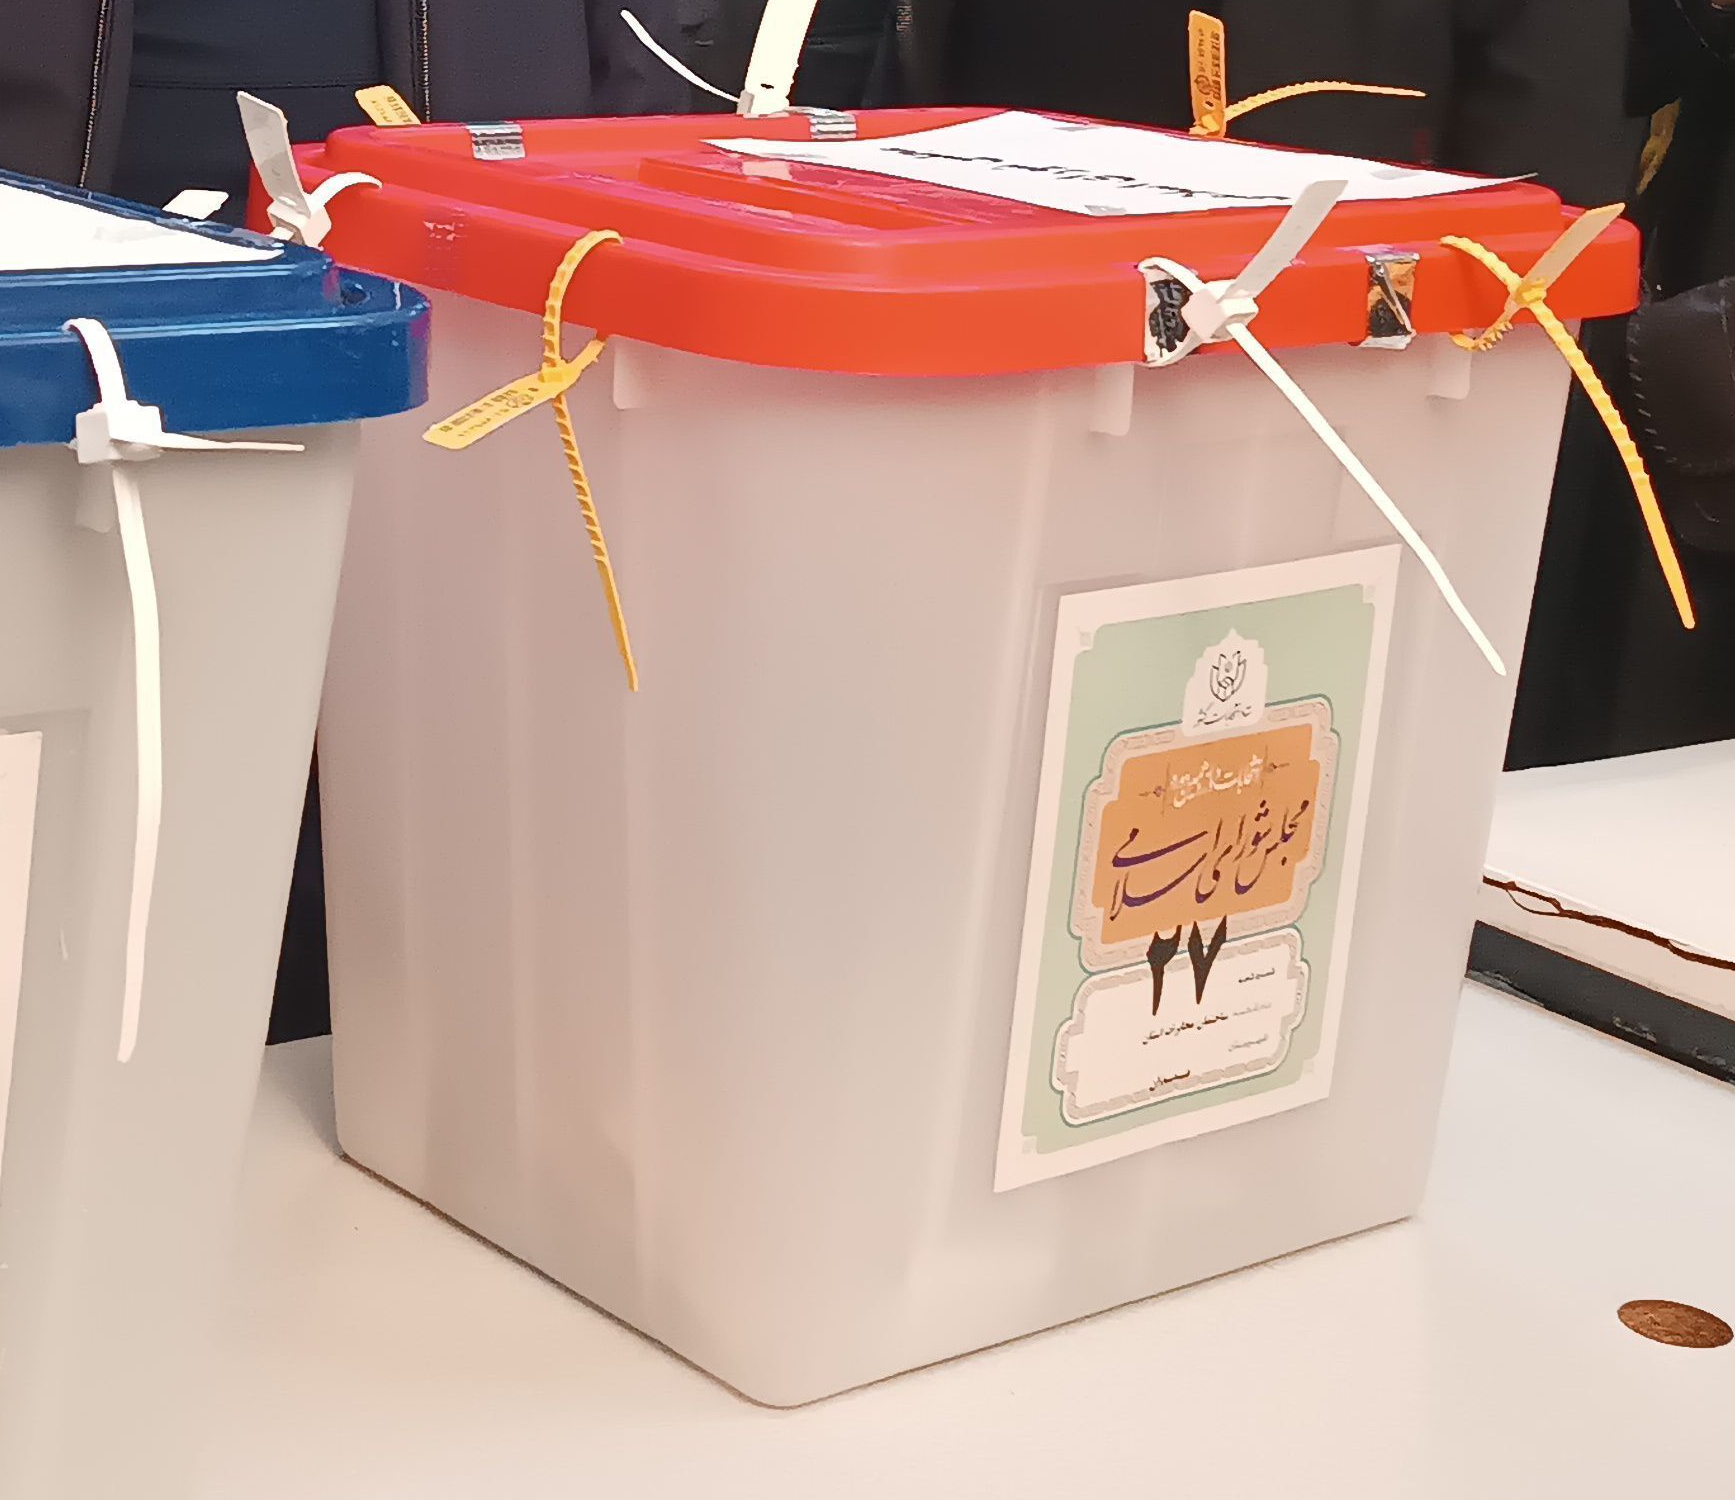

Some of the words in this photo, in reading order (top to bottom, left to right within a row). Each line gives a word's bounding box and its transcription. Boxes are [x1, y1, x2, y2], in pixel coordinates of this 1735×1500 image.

[1110, 817, 1223, 921] اسلامی
[1195, 800, 1272, 904] شورای
[1234, 800, 1310, 895] مجلس
[1146, 914, 1228, 1016] ۲۷
